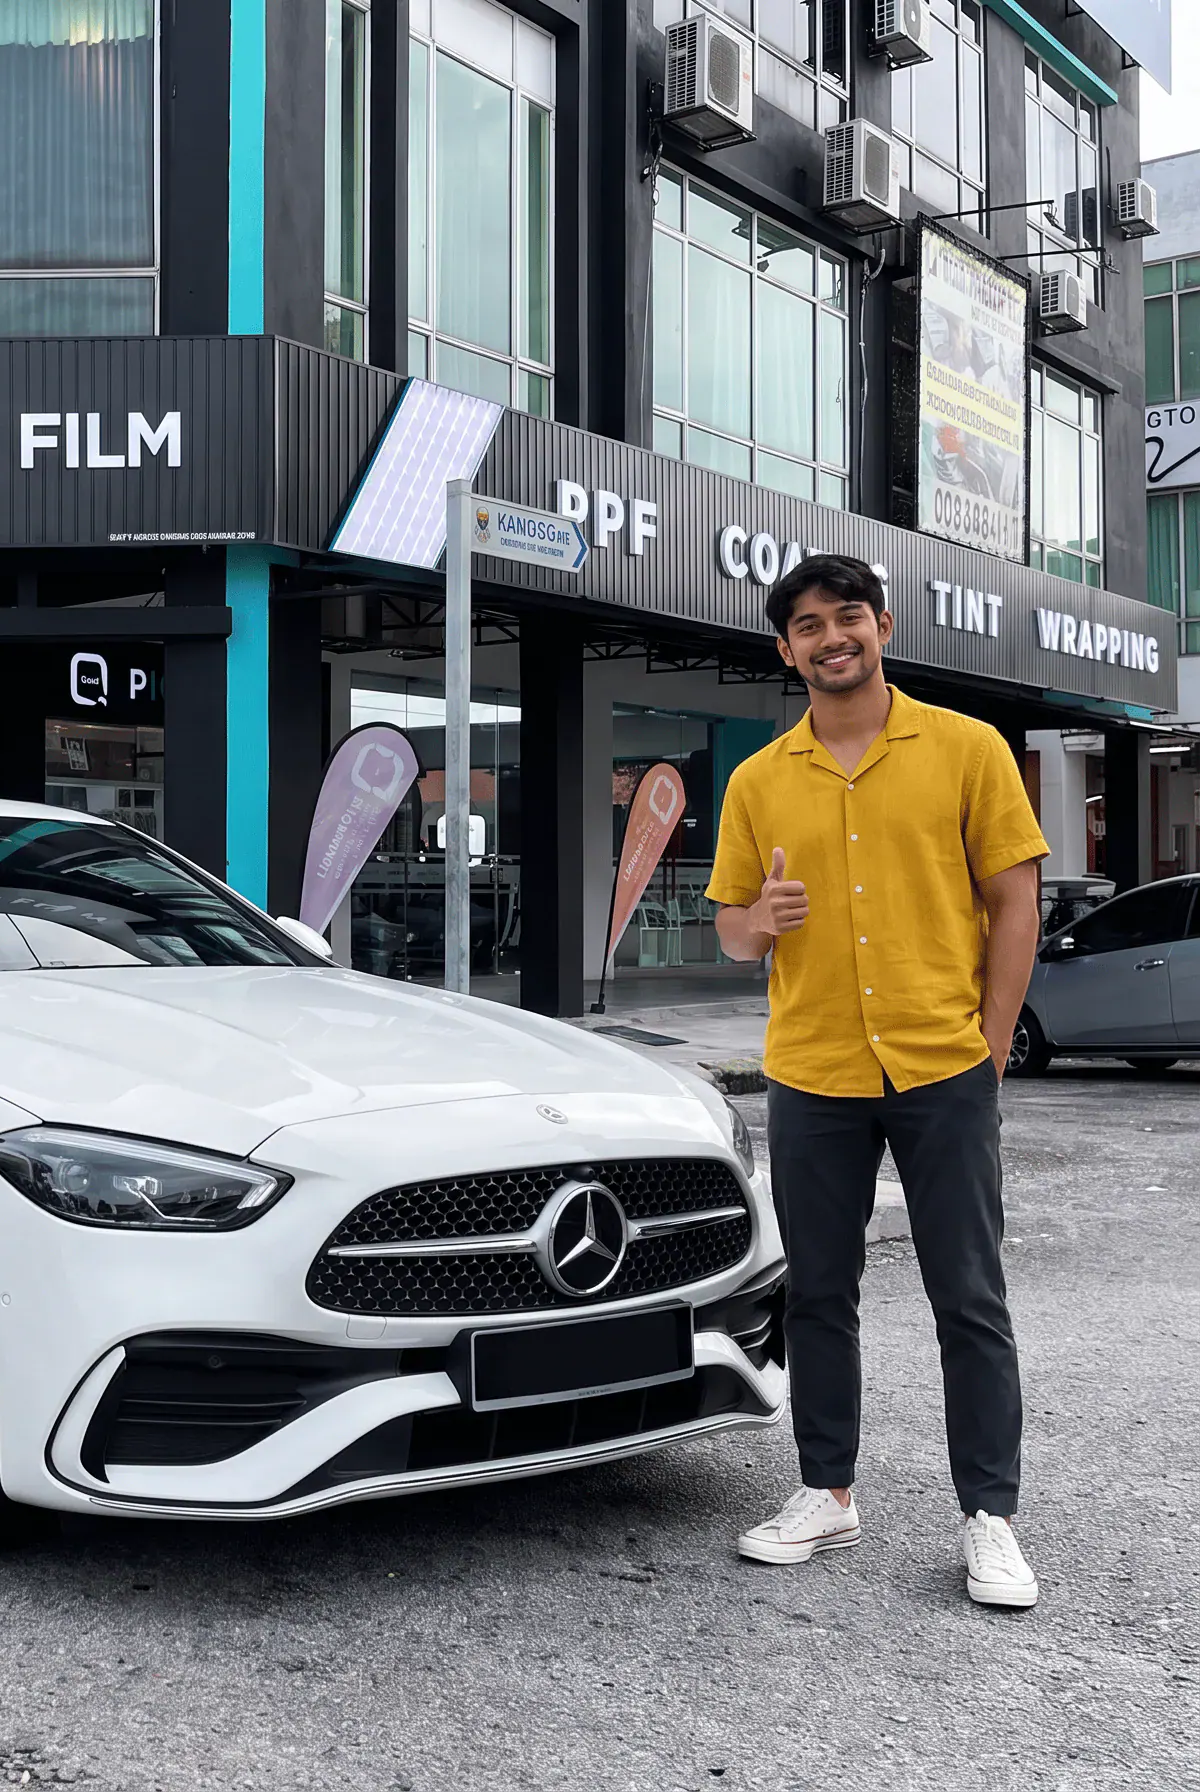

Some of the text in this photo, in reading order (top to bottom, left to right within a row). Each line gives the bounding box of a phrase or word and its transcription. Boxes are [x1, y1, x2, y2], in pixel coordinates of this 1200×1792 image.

[20, 411, 182, 469] FILM
[556, 479, 657, 556] PPF
[930, 580, 1160, 674] TINT WRAPPING
